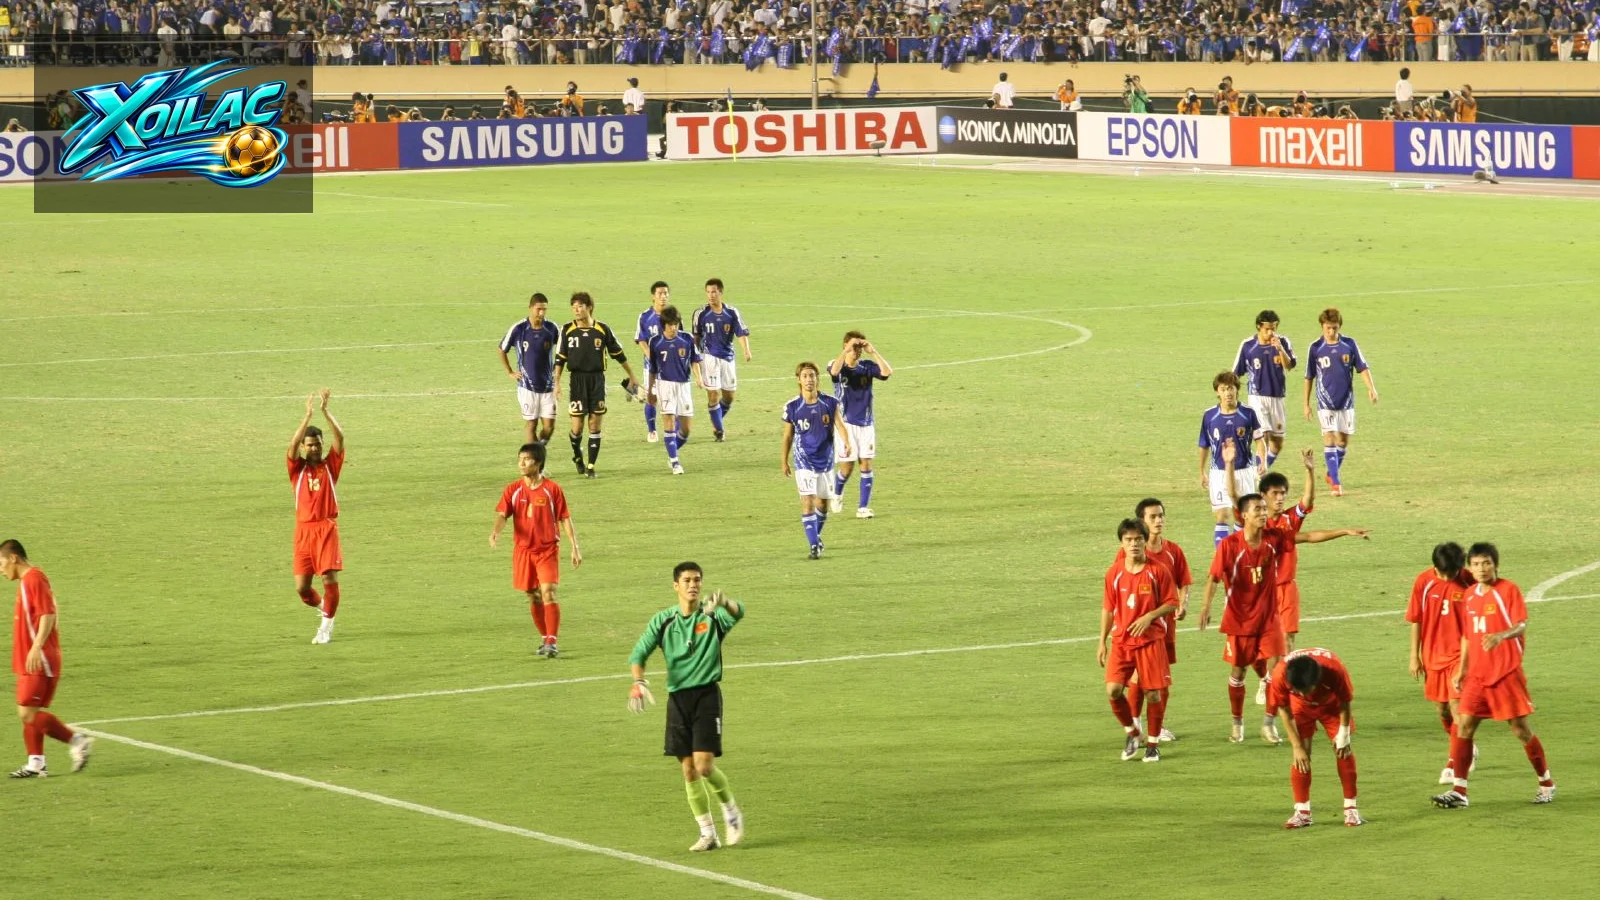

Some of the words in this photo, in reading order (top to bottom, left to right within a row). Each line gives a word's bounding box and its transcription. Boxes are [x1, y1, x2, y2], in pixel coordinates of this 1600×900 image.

[675, 110, 928, 155] TOSHIBA
[957, 119, 1012, 144] KONICA
[1013, 122, 1076, 146] MINOLTA
[1107, 116, 1198, 159] EPSON
[421, 119, 625, 162] SAMSUNG
[1259, 123, 1363, 167] maxell
[1409, 127, 1556, 171] SAMSUNG
[705, 322, 715, 333] 11
[522, 340, 529, 352] 9
[568, 336, 579, 348] 21
[660, 350, 668, 362] 7
[1318, 356, 1331, 368] 10
[1253, 358, 1261, 370] 8
[570, 400, 583, 412] 21
[797, 418, 811, 431] 16
[1213, 427, 1220, 441] 4
[1126, 593, 1136, 610] 4
[1441, 599, 1449, 615] 3
[1472, 616, 1486, 634] 14
